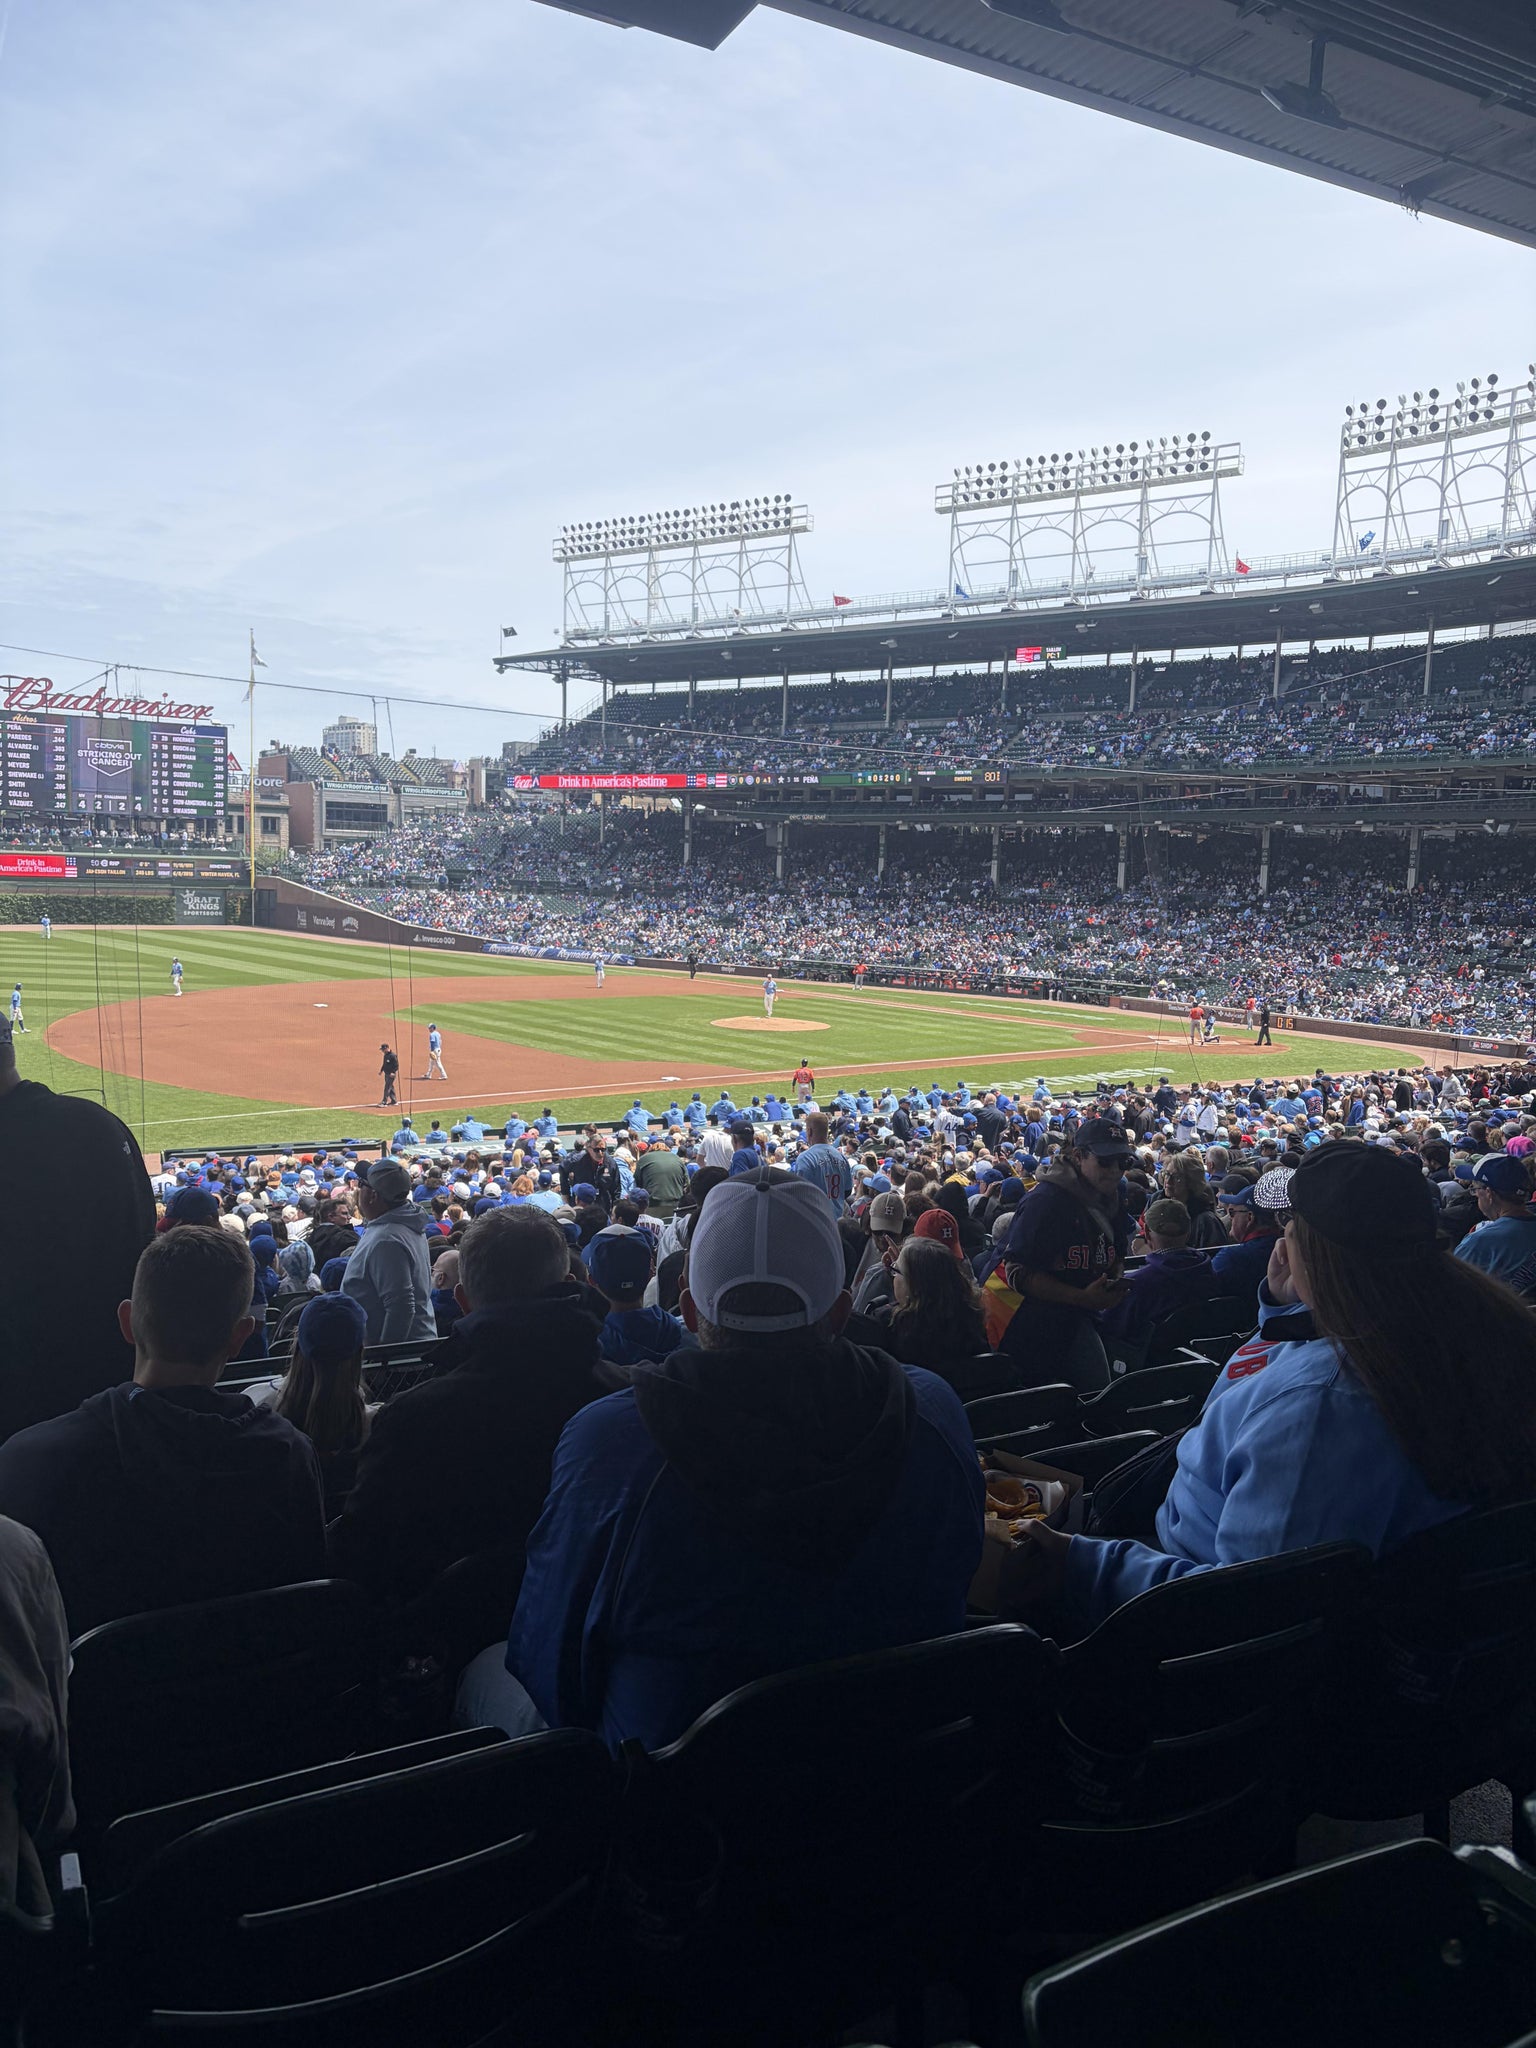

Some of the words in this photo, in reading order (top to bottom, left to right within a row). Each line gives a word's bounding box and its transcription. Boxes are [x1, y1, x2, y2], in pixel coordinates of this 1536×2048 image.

[0, 675, 214, 720] Budweiser
[12, 713, 37, 723] Astros
[180, 726, 197, 735] Cubs
[8, 733, 32, 741] PAREDES
[78, 750, 122, 758] STRIKING
[124, 752, 142, 760] OUT
[91, 758, 129, 766] CANCER
[8, 771, 37, 779] SHEWMAKE
[802, 775, 818, 784] PEÑA
[873, 774, 878, 782] 0
[884, 774, 889, 782] 2
[895, 774, 900, 782] 0
[984, 771, 996, 782] 80
[242, 774, 284, 788] Moore
[558, 776, 581, 788] Drink
[592, 776, 631, 788] America's
[632, 776, 668, 788] Pastime
[326, 782, 388, 792] WRIGLEYROOFTOPS.COM
[404, 787, 462, 796] WRIGLEYROOFTOPS.COM
[8, 799, 34, 807] VÁZQUEZ
[78, 800, 86, 808] 4
[95, 801, 102, 810] 2
[119, 802, 126, 810] 2
[134, 803, 142, 812] 4
[17, 858, 38, 866] Drink
[0, 865, 32, 874] America's
[34, 866, 62, 874] Pastime
[184, 896, 221, 904] DRAFT
[422, 934, 444, 944] Invesco
[444, 936, 456, 945] QQQ
[489, 944, 520, 956] Reynolds
[557, 948, 590, 961] Reynolds
[1278, 1016, 1284, 1028] 0
[944, 1122, 958, 1134] 44
[826, 1174, 840, 1200] 18
[884, 1206, 894, 1216] H
[942, 1228, 952, 1238] H
